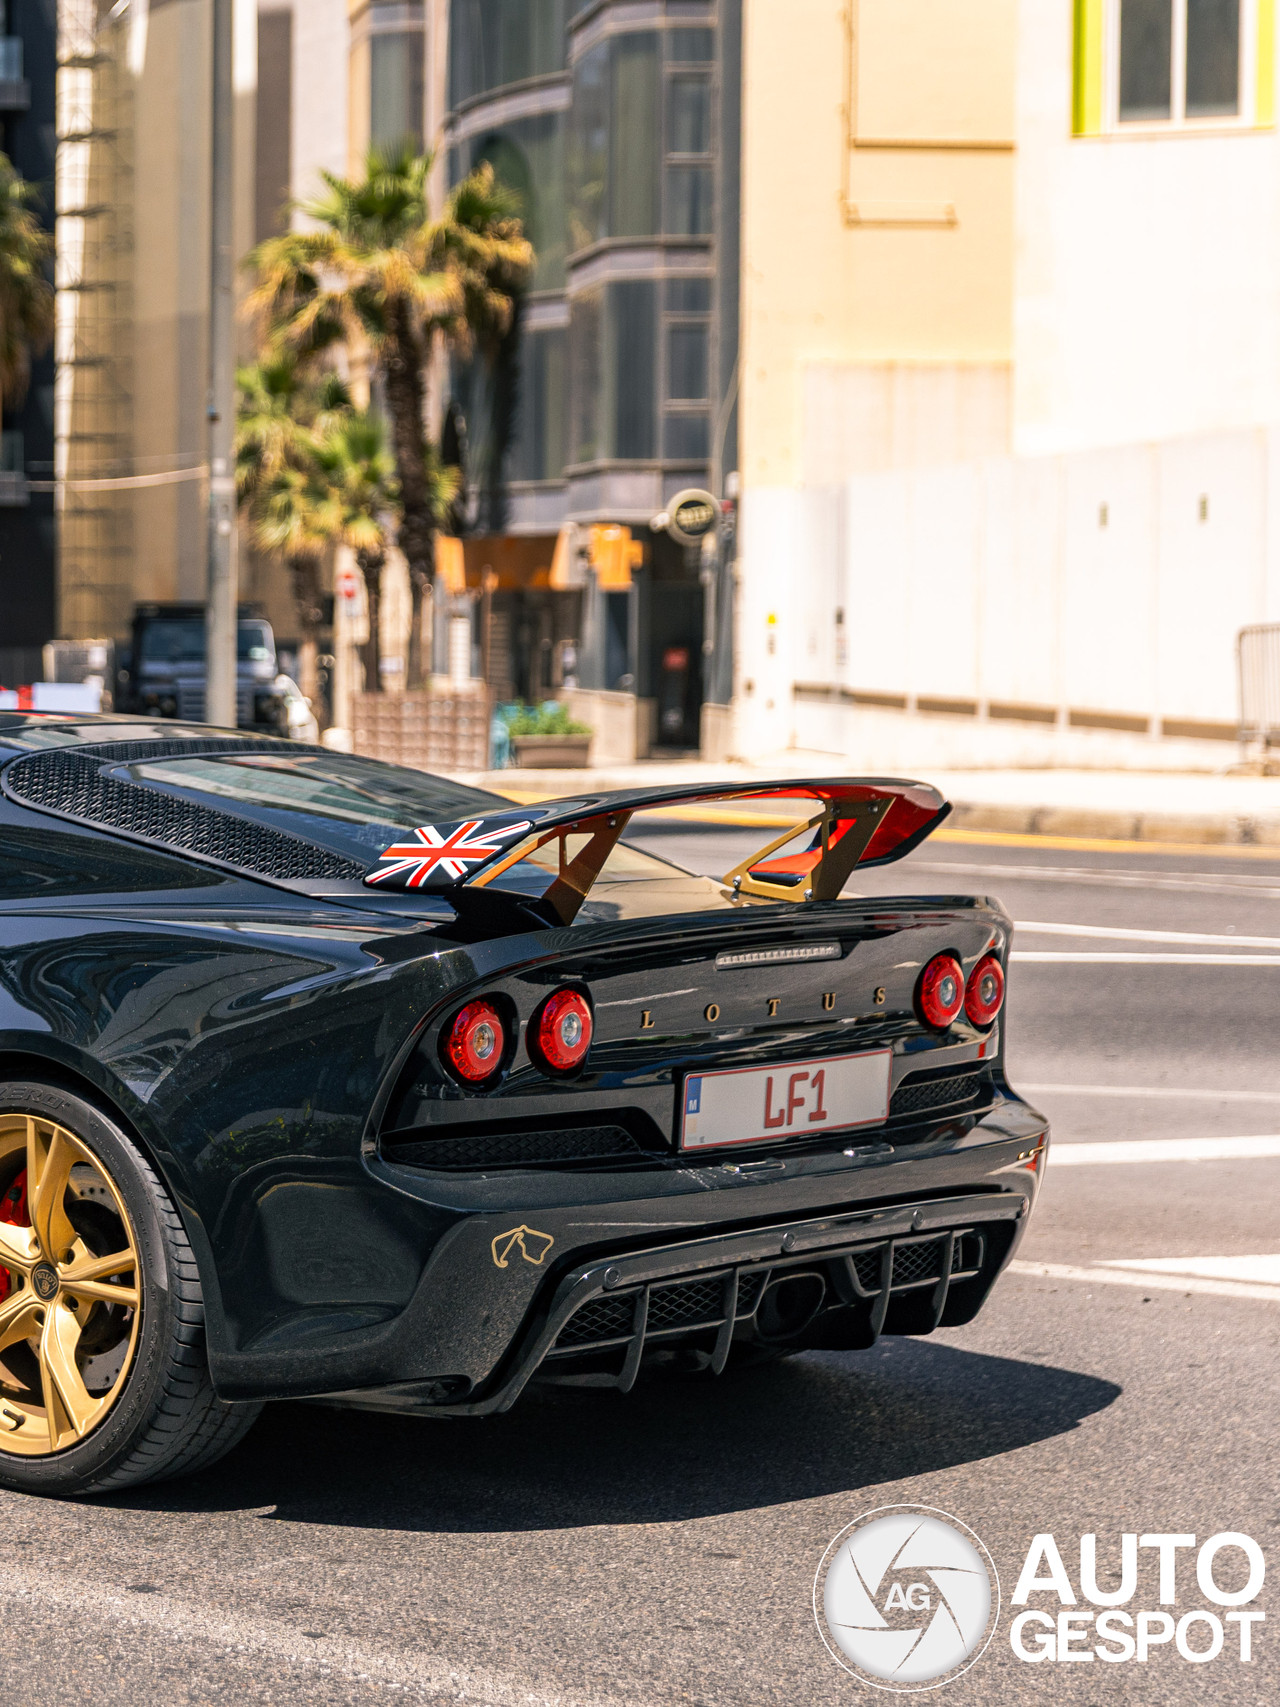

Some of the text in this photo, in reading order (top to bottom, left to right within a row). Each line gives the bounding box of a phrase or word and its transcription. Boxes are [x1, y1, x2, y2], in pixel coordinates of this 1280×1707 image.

[640, 986, 887, 1029] LOTUS
[688, 1098, 698, 1112] M
[764, 1069, 828, 1129] LF1
